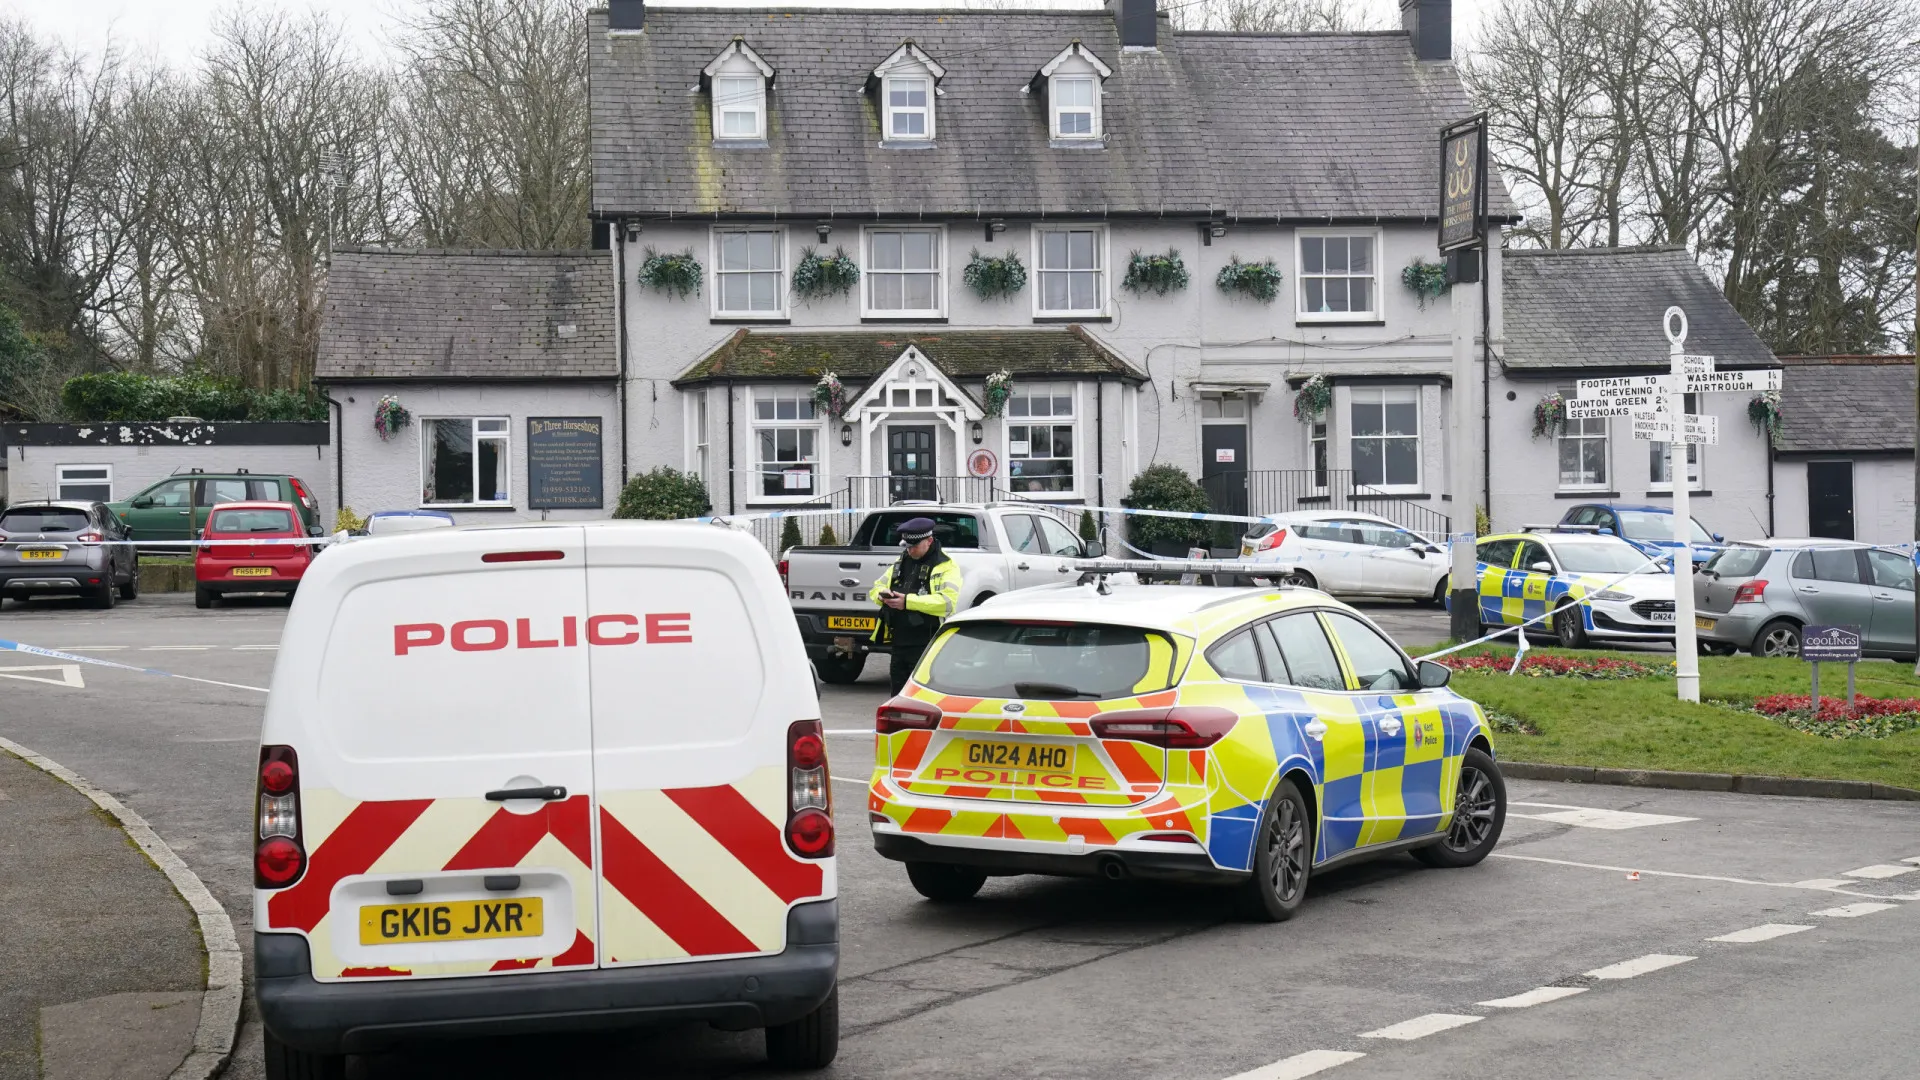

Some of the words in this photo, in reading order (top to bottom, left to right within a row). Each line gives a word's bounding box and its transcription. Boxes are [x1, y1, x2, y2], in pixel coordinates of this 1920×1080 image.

[1684, 356, 1704, 365] SCHOOL
[1687, 372, 1743, 382] WASHNEYS
[1581, 379, 1630, 388] FOOTPATH
[1687, 382, 1753, 392] FAIRTROUGH
[1600, 387, 1652, 397] CHEVENING
[1570, 400, 1608, 408] DUNTON
[1616, 397, 1647, 406] GREEN
[1571, 408, 1629, 418] SEVENOAKS
[1634, 412, 1655, 420] HALSTEAD
[531, 421, 542, 435] The
[544, 421, 561, 431] Three
[563, 420, 599, 435] Horseshoes
[1635, 422, 1658, 430] KNOCKHOLT
[1635, 431, 1653, 440] BROMLEY
[791, 590, 866, 601] RANG
[834, 618, 852, 626] MC19
[854, 618, 870, 628] CKV
[394, 612, 692, 656] POLICE
[1424, 722, 1434, 731] Kent
[1425, 736, 1437, 745] Police
[969, 744, 1020, 765] GN24
[1026, 747, 1066, 768] AHO
[934, 768, 1106, 789] POLICE
[381, 906, 451, 938] GK16
[462, 902, 523, 934] JXR
